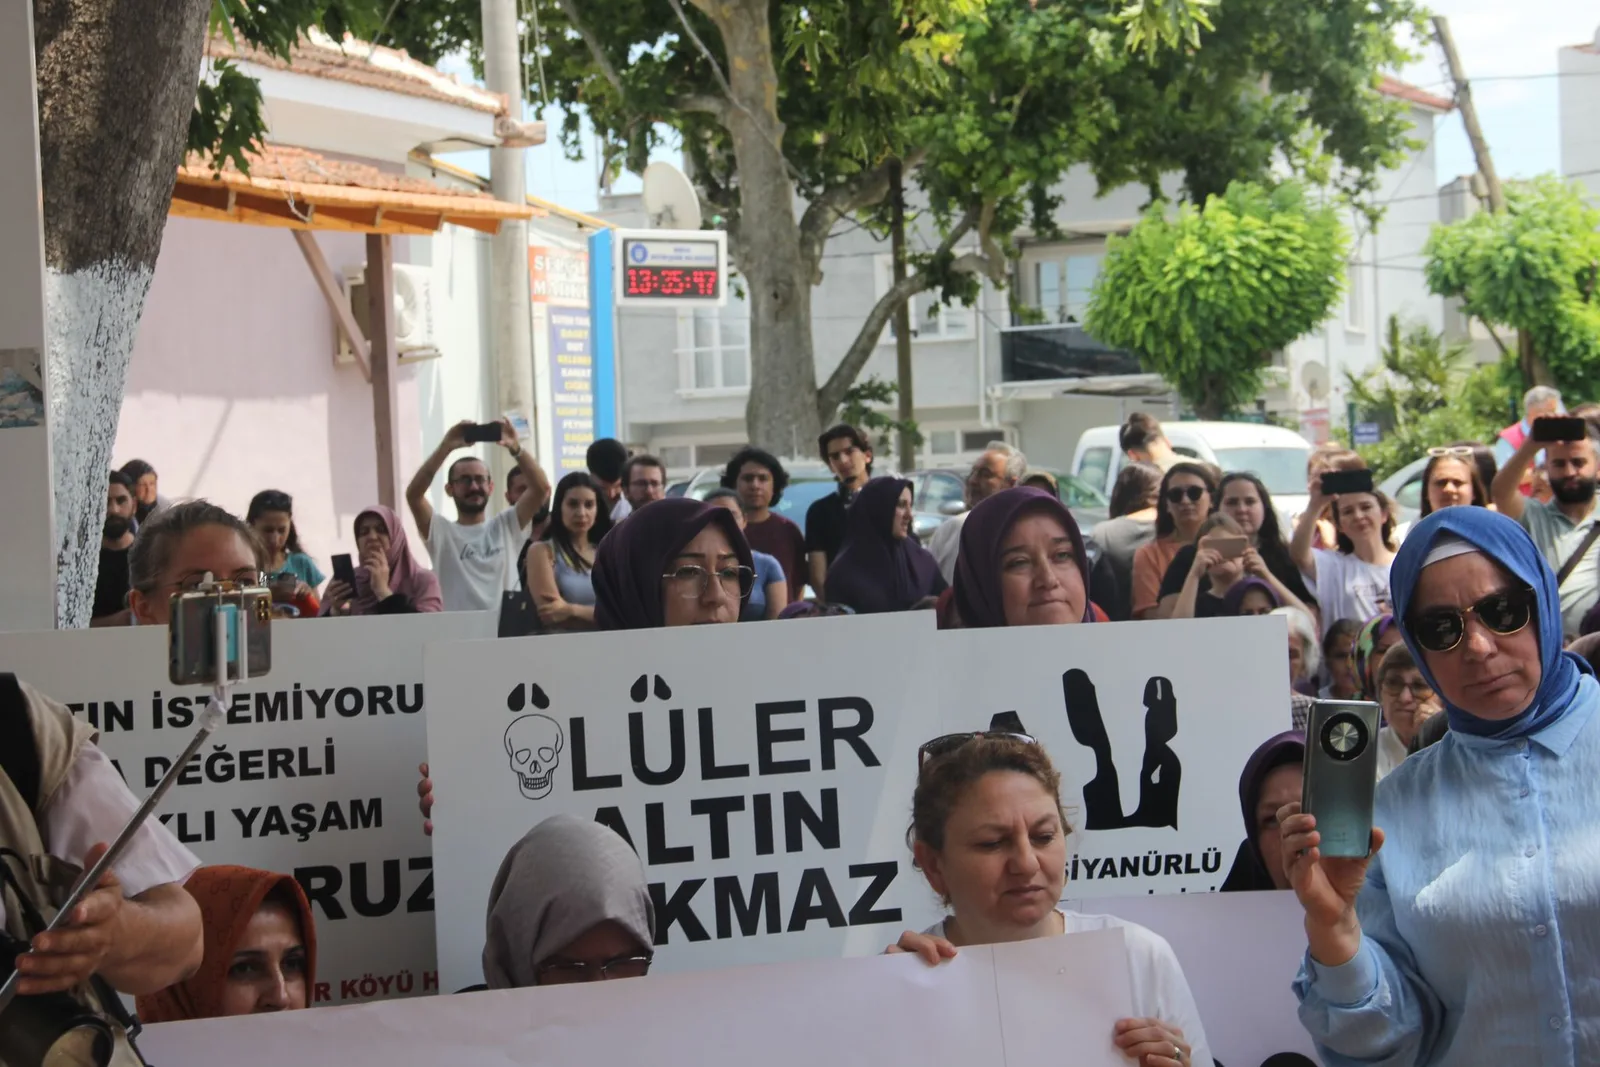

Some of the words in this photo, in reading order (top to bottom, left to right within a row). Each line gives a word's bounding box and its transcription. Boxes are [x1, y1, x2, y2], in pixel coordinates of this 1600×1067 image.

[627, 269, 717, 295] 13:35:47
[145, 737, 336, 789] DEĞERLİ
[231, 797, 383, 842] YAŞAM
[341, 970, 413, 1000] KÖYÜ
